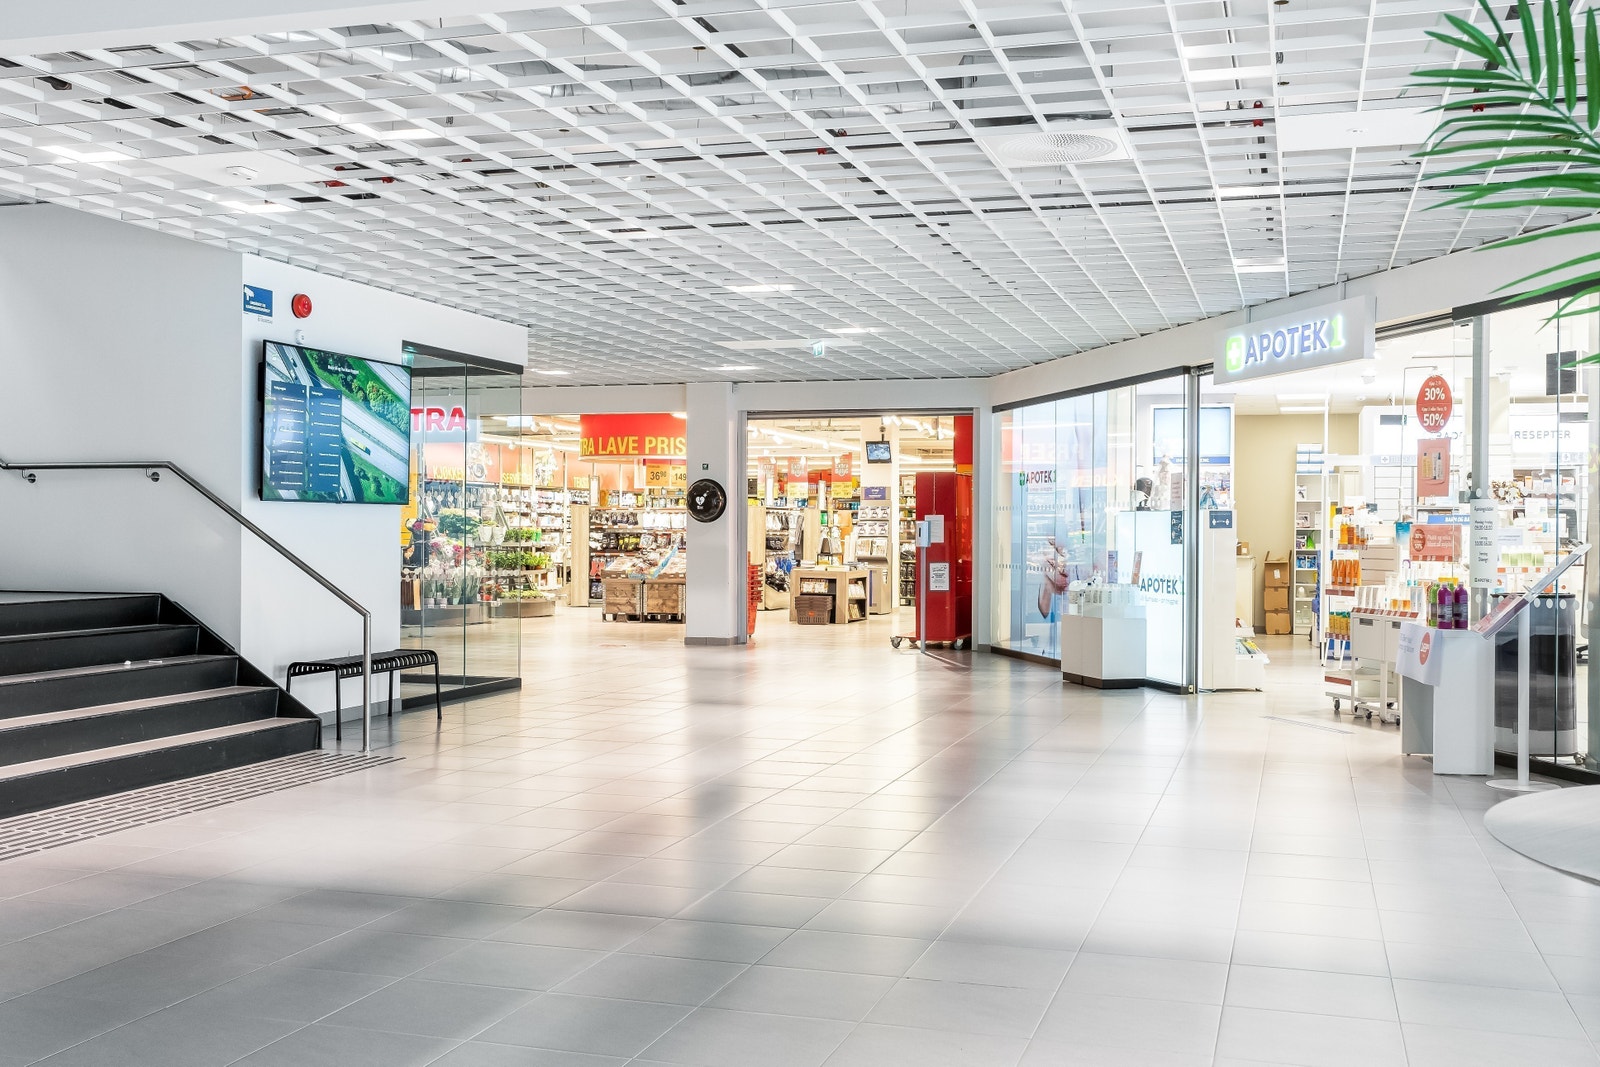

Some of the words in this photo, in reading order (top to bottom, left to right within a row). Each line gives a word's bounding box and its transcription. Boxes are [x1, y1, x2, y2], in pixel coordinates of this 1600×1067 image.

[1244, 320, 1328, 365] APOTEK
[1329, 315, 1345, 348] 1
[1424, 387, 1446, 401] 30%
[410, 407, 468, 431] TRA
[1423, 413, 1445, 427] 50%
[1514, 431, 1571, 440] RESEPTER
[598, 436, 639, 455] LAVE
[644, 436, 686, 456] PRIS
[1025, 470, 1052, 484] APOTEK
[1140, 578, 1178, 595] APOTEK
